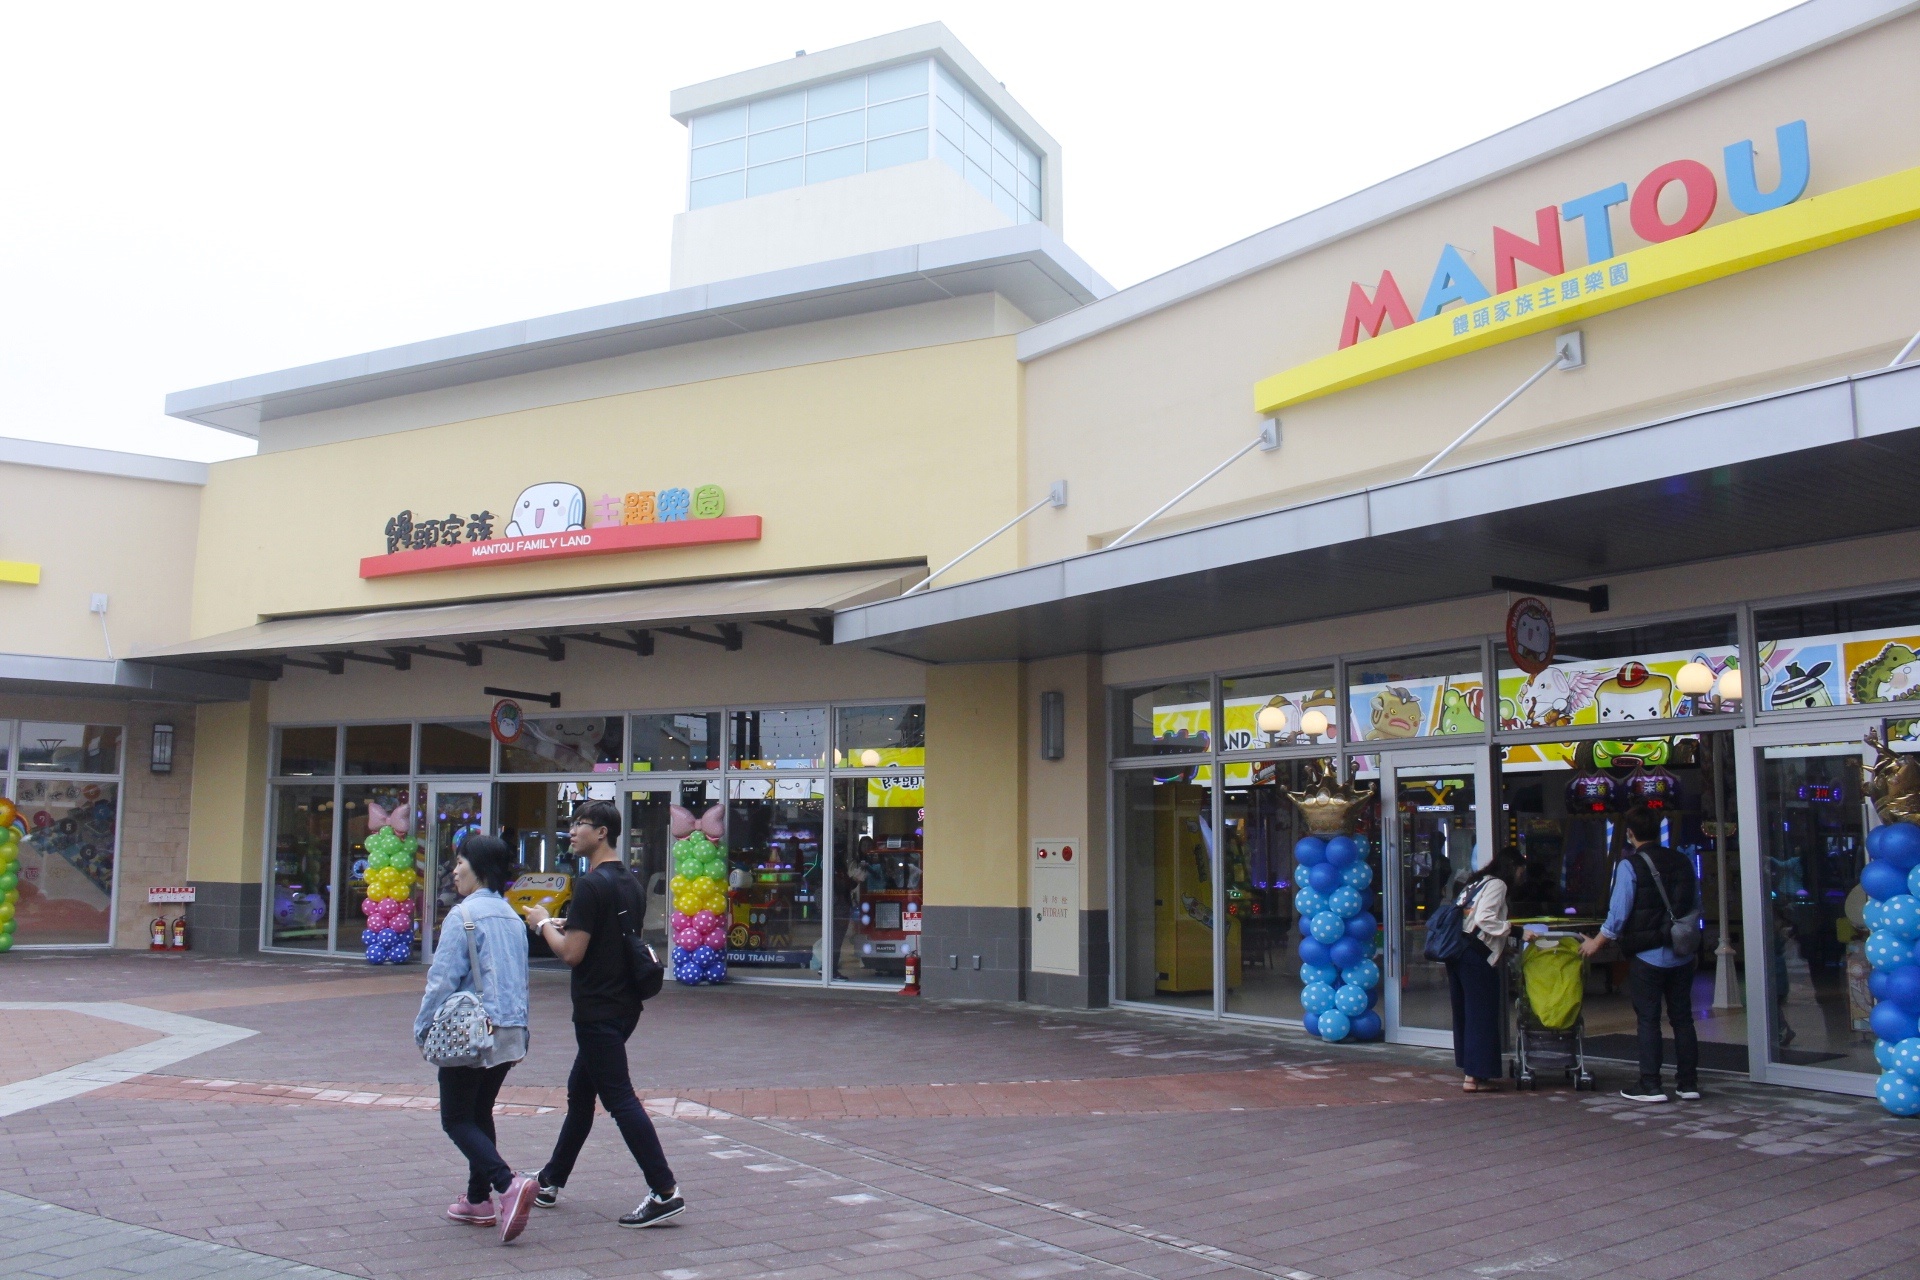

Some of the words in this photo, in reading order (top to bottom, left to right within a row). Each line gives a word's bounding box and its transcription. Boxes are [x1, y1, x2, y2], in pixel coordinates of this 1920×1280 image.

[1338, 119, 1811, 351] MANTOU
[1452, 262, 1629, 336] 饅頭家族主題樂園
[591, 484, 726, 529] 主題樂園
[472, 542, 515, 557] MANTOU
[516, 537, 558, 552] FAMILY
[560, 534, 592, 548] LAND
[1224, 732, 1251, 750] ND
[1622, 743, 1634, 753] 7
[727, 953, 746, 961] TOU
[748, 954, 775, 962] TRAIN
